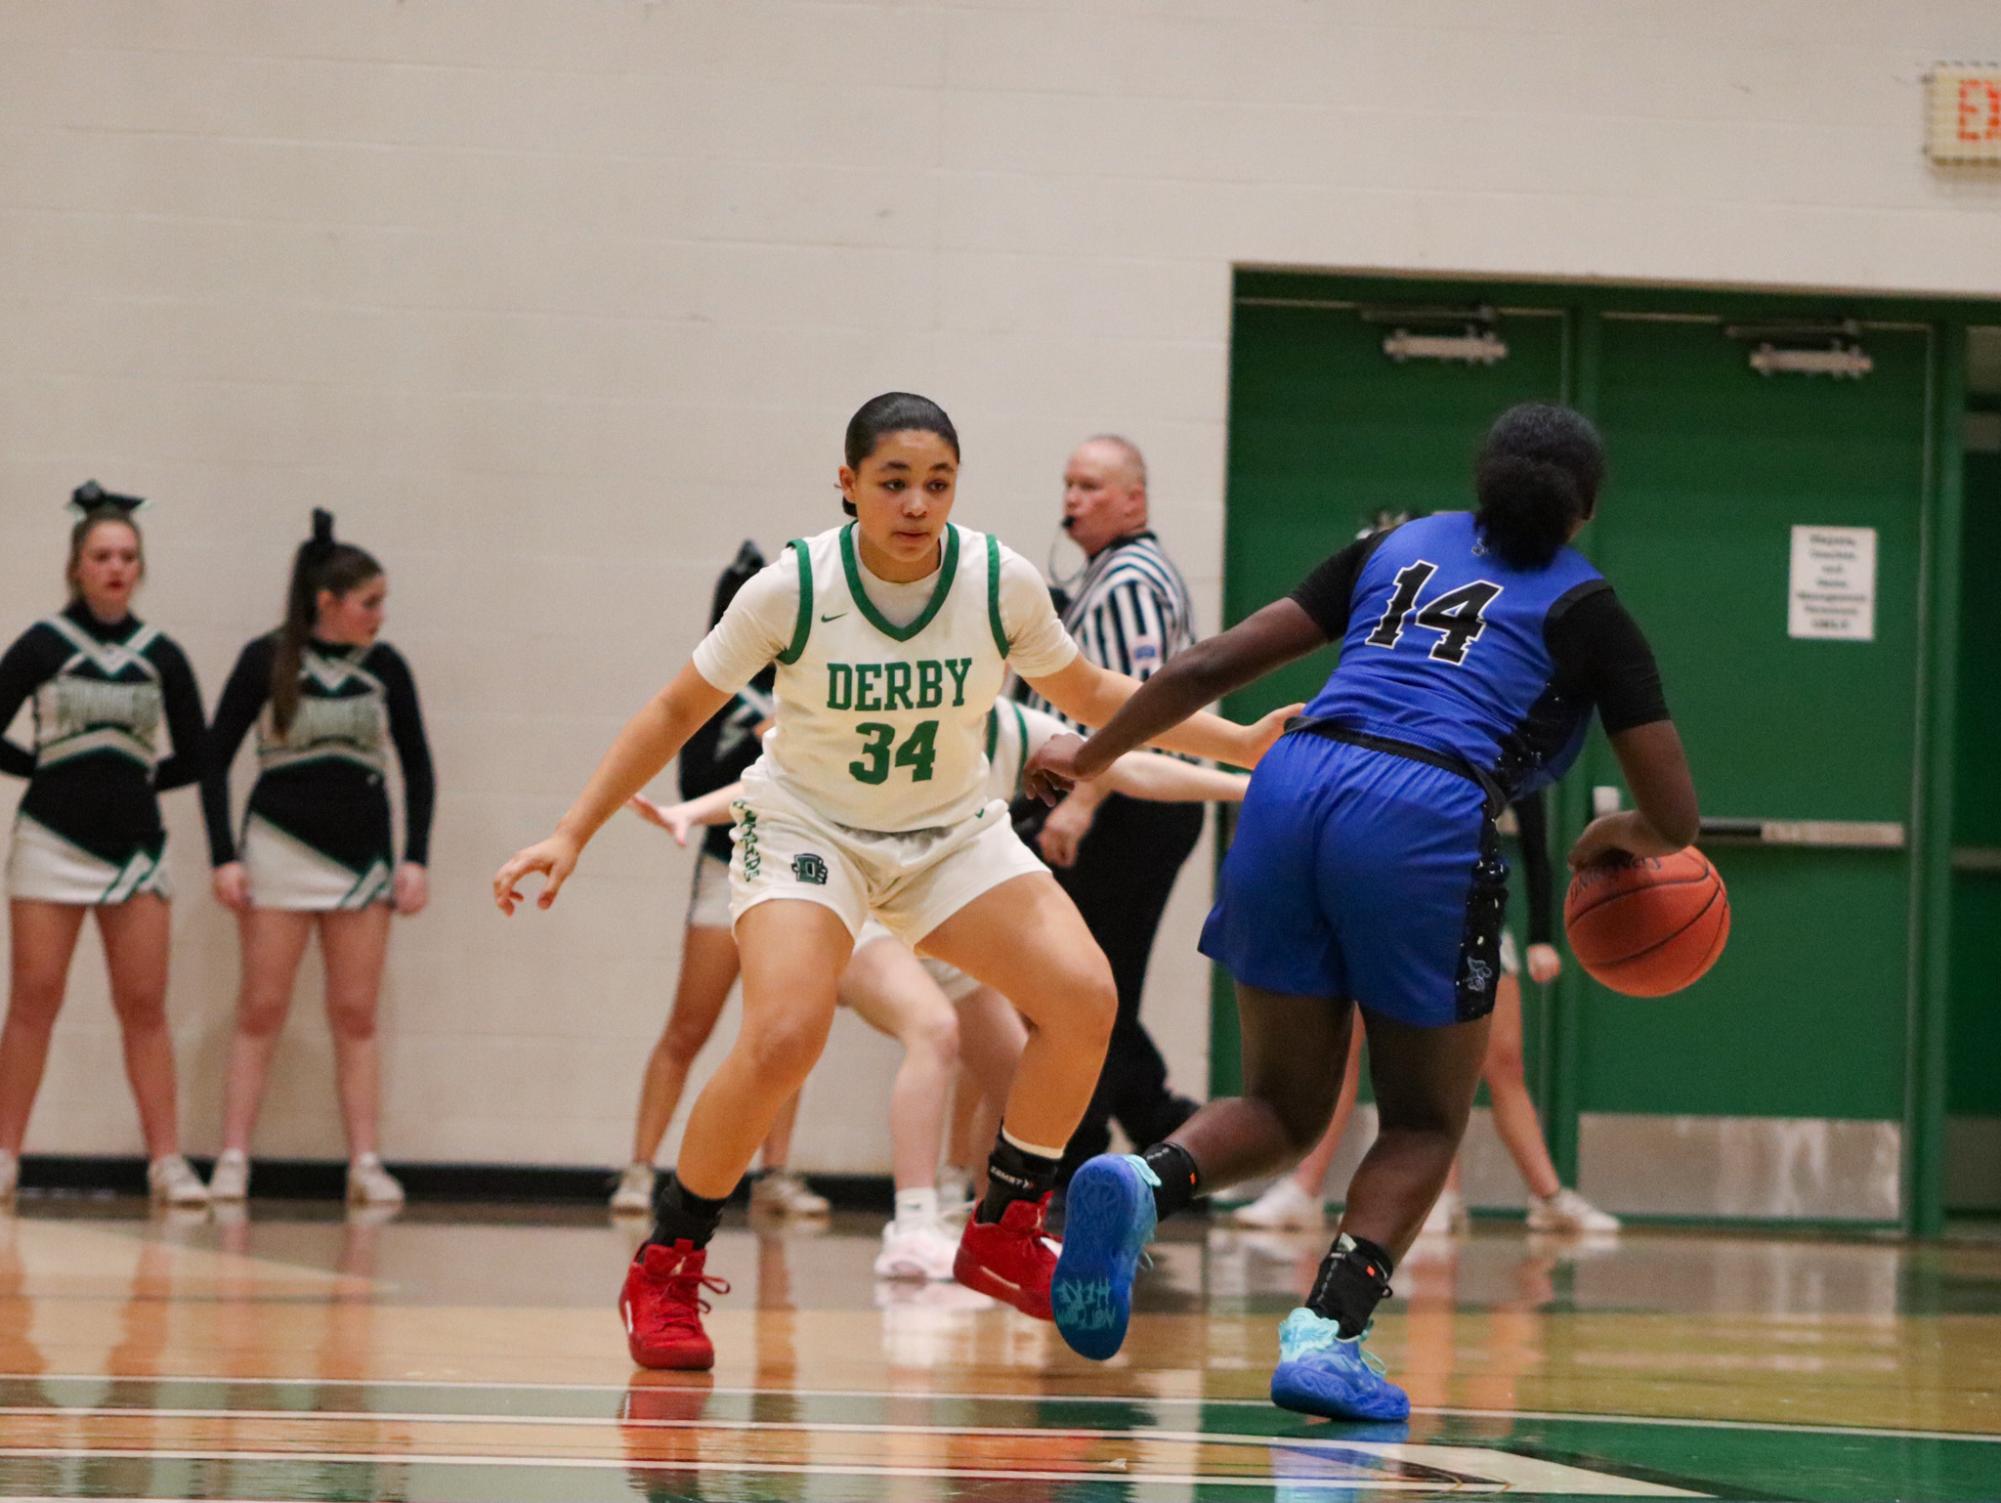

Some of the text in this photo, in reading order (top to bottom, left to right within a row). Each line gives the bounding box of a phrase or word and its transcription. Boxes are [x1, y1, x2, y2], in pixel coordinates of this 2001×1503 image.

[1365, 559, 1504, 666] 14
[826, 658, 972, 711] DERBY
[849, 720, 939, 785] 34
